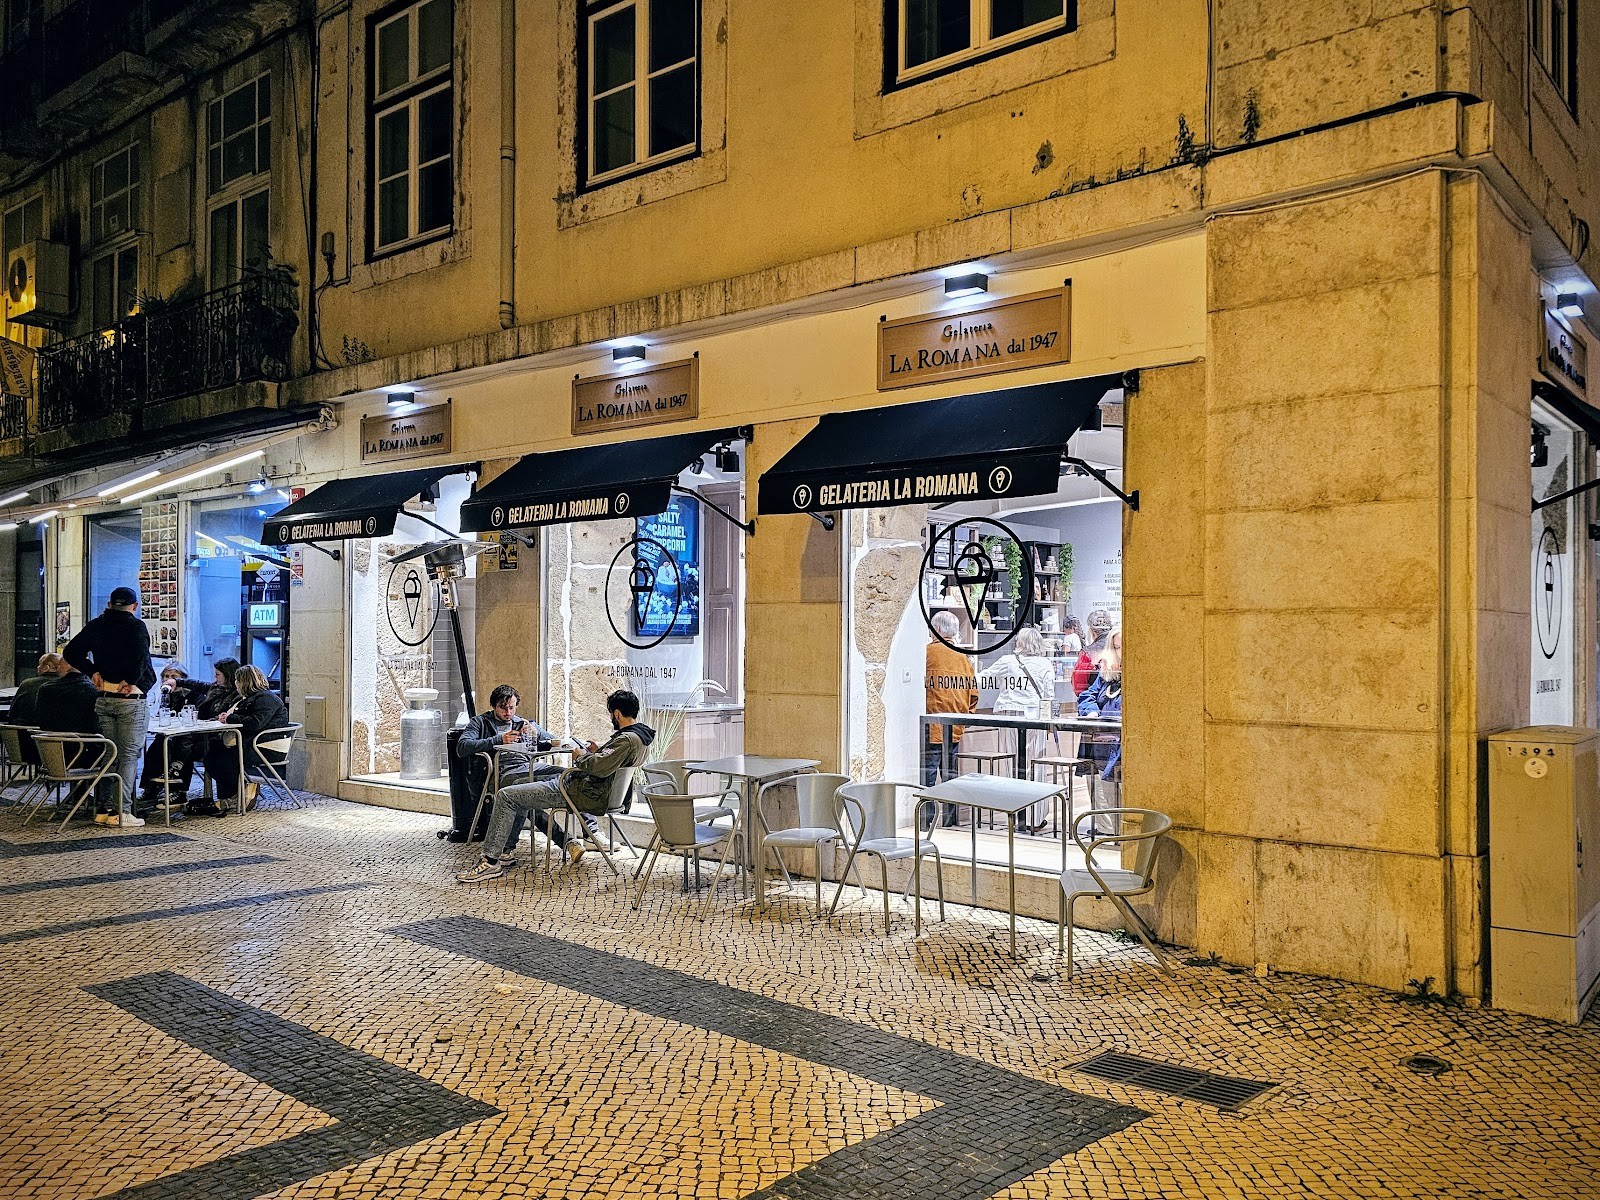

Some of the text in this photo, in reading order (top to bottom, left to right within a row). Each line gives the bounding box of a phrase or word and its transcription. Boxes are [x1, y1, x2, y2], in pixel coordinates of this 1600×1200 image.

[943, 320, 993, 338] Gelateria
[917, 342, 1000, 369] ROMANA
[1006, 338, 1025, 354] dal
[1029, 331, 1058, 350] 1947
[596, 399, 652, 420] ROMANA
[654, 397, 667, 410] dal
[669, 393, 688, 408] 1947
[379, 437, 419, 452] ROMANA
[819, 471, 979, 506] GELATERIA LA ROMANA
[508, 497, 609, 524] GELATERIA LA ROMANA
[658, 511, 680, 525] SALTY
[291, 519, 362, 540] GELATERIA LA ROMANA
[652, 523, 687, 539] CARAMEL
[253, 609, 275, 621] ATM
[616, 666, 643, 678] ROMANA
[644, 666, 657, 678] DAL
[660, 667, 677, 679] 1947
[924, 676, 1029, 691] LA ROMANA DAL 1947
